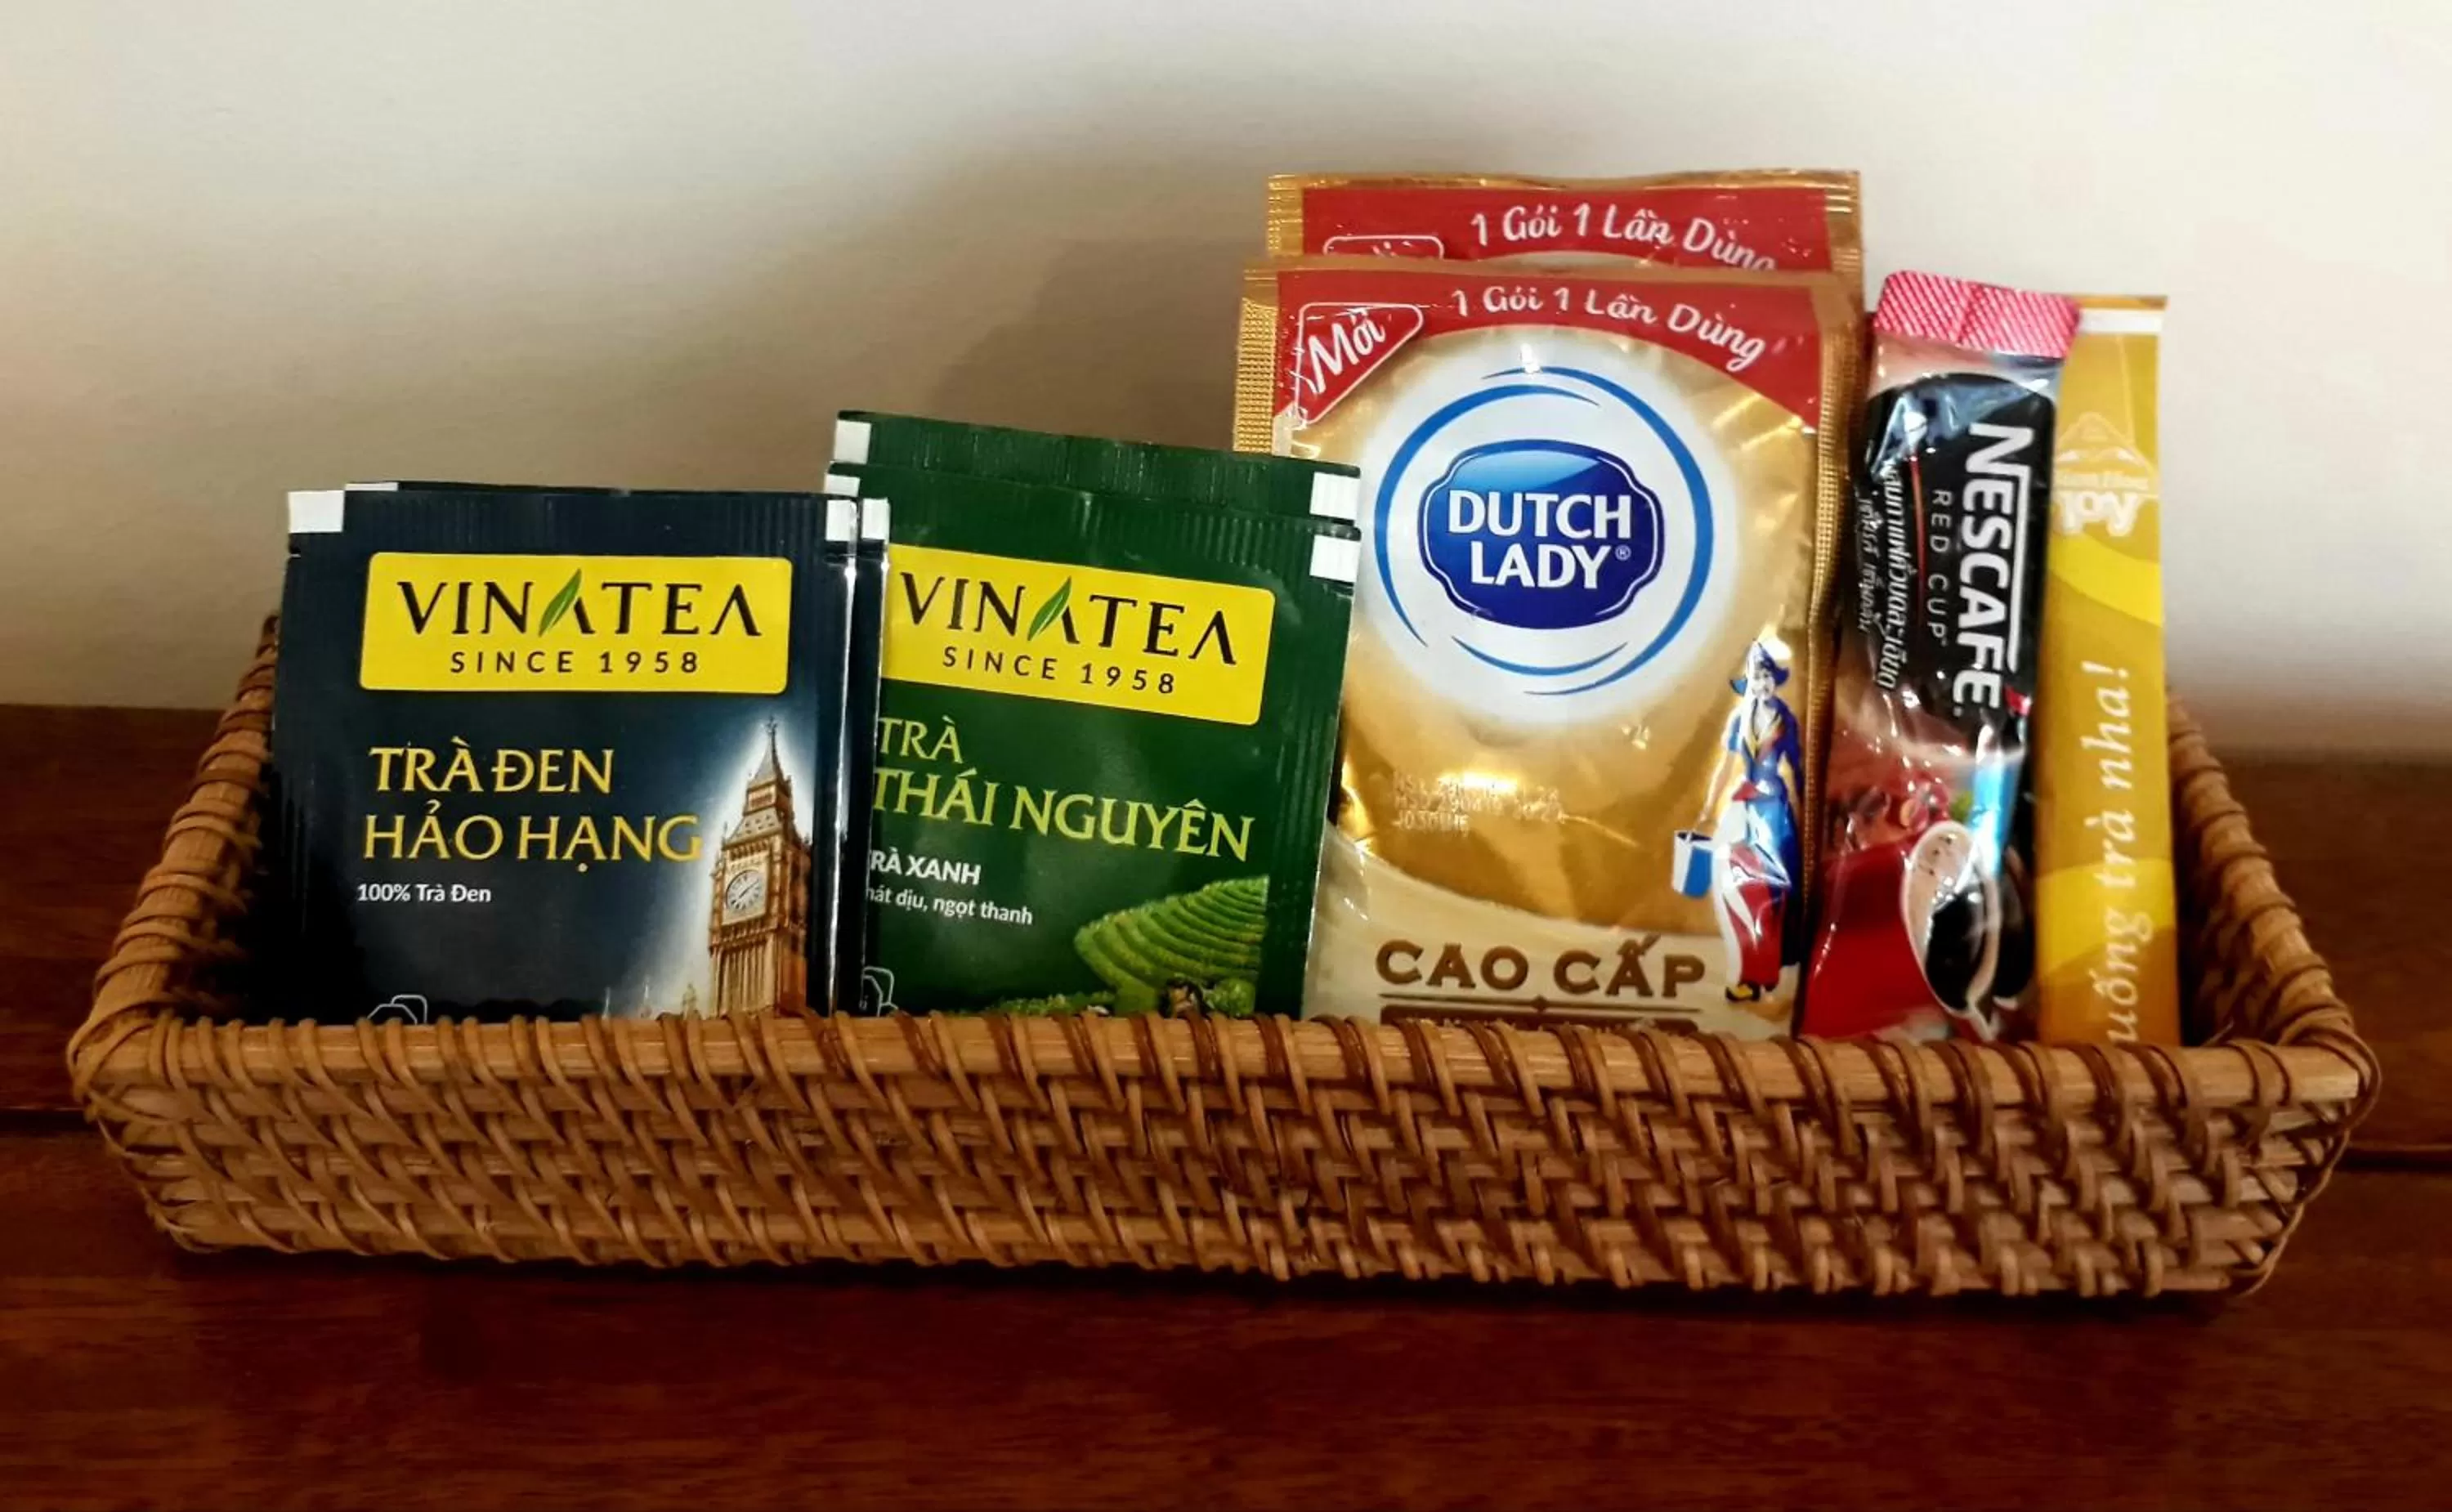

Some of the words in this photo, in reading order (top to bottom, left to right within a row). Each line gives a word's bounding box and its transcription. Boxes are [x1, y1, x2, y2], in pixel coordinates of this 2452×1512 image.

[1471, 214, 1488, 247] 1
[1502, 204, 1562, 243] Gói
[1572, 203, 1589, 235] 1
[1602, 204, 1674, 248] Lần
[1452, 289, 1469, 317] 1
[1483, 284, 1544, 314] Gói
[1555, 284, 1570, 311] 1
[1584, 289, 1658, 324] Lần
[1668, 305, 1766, 374] Dùng
[1447, 489, 1633, 540] DUTCH
[1930, 490, 1953, 555] RED
[396, 567, 763, 637] VINATEA
[899, 571, 1237, 666] VINATEA
[1926, 574, 1950, 639] CUP
[450, 651, 575, 673] SINCE
[599, 651, 700, 674] 1958
[942, 646, 1058, 681] SINCE
[1080, 664, 1177, 695] 1958
[877, 715, 964, 763] TRÀ
[2080, 660, 2137, 790] nha!
[369, 736, 481, 794] TRÀ
[491, 748, 614, 794] ĐEN
[362, 800, 503, 861] HẢO
[517, 814, 703, 874] HẠNG
[871, 768, 997, 828] THÁI
[1009, 785, 1255, 862] NGUYÊN
[869, 847, 903, 876] RÀ
[906, 855, 982, 886] XANH
[2084, 808, 2138, 890] trà
[356, 883, 411, 902] 100%
[415, 883, 446, 902] Trà
[450, 883, 492, 904] Đen
[933, 896, 978, 919] ngọt
[980, 901, 1034, 925] thanh
[1375, 939, 1531, 991] CAO
[1552, 934, 1706, 999] CẤP
[2093, 909, 2154, 1046] uống
